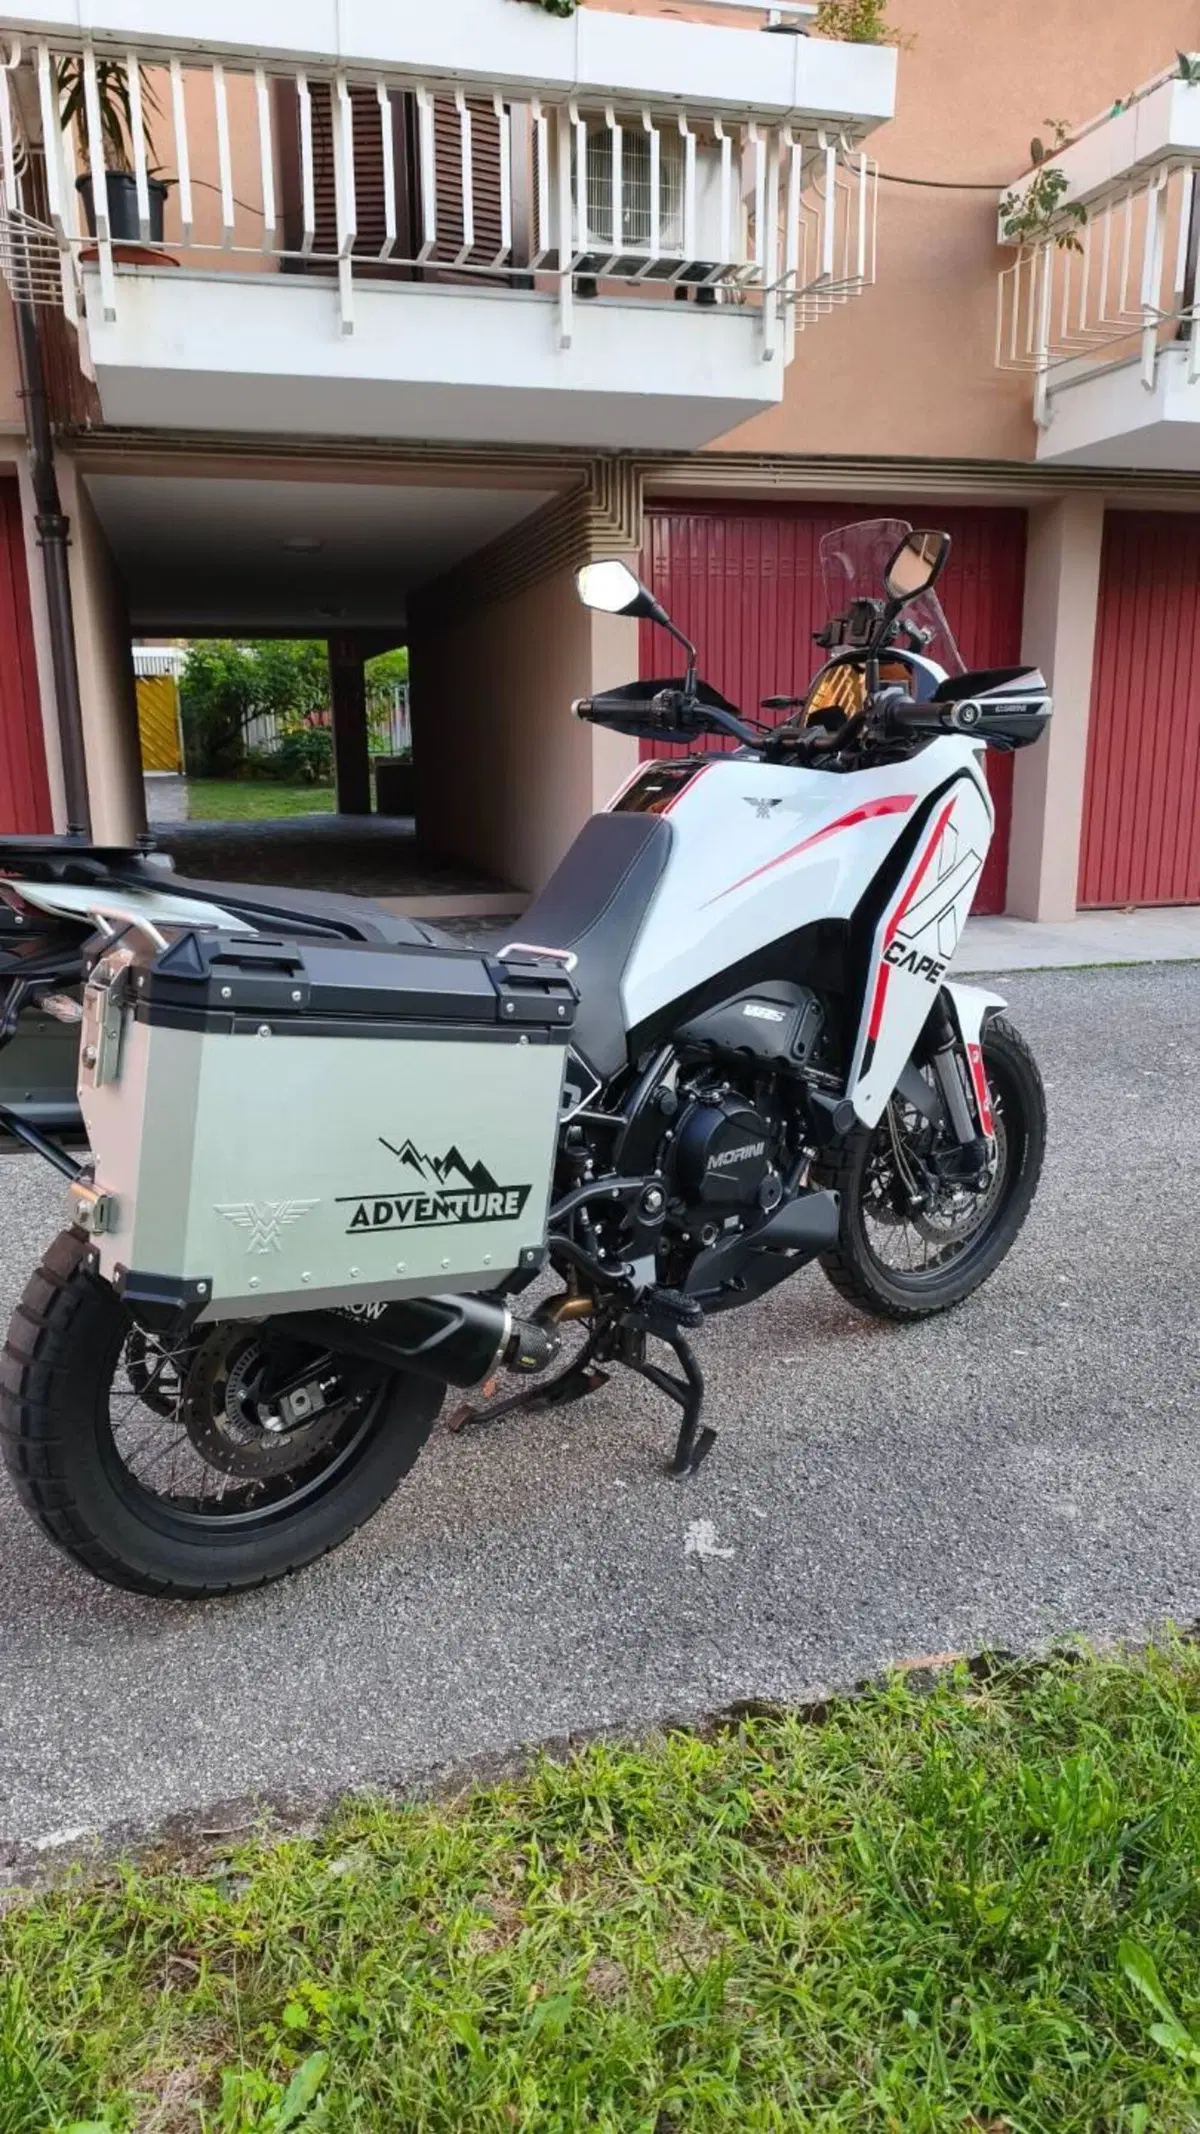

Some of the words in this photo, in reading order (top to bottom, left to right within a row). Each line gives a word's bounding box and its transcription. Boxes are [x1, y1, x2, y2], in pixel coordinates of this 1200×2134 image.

[883, 940, 946, 984] CAPE
[707, 1141, 765, 1170] MORINI
[350, 1191, 520, 1227] ADVENTURE
